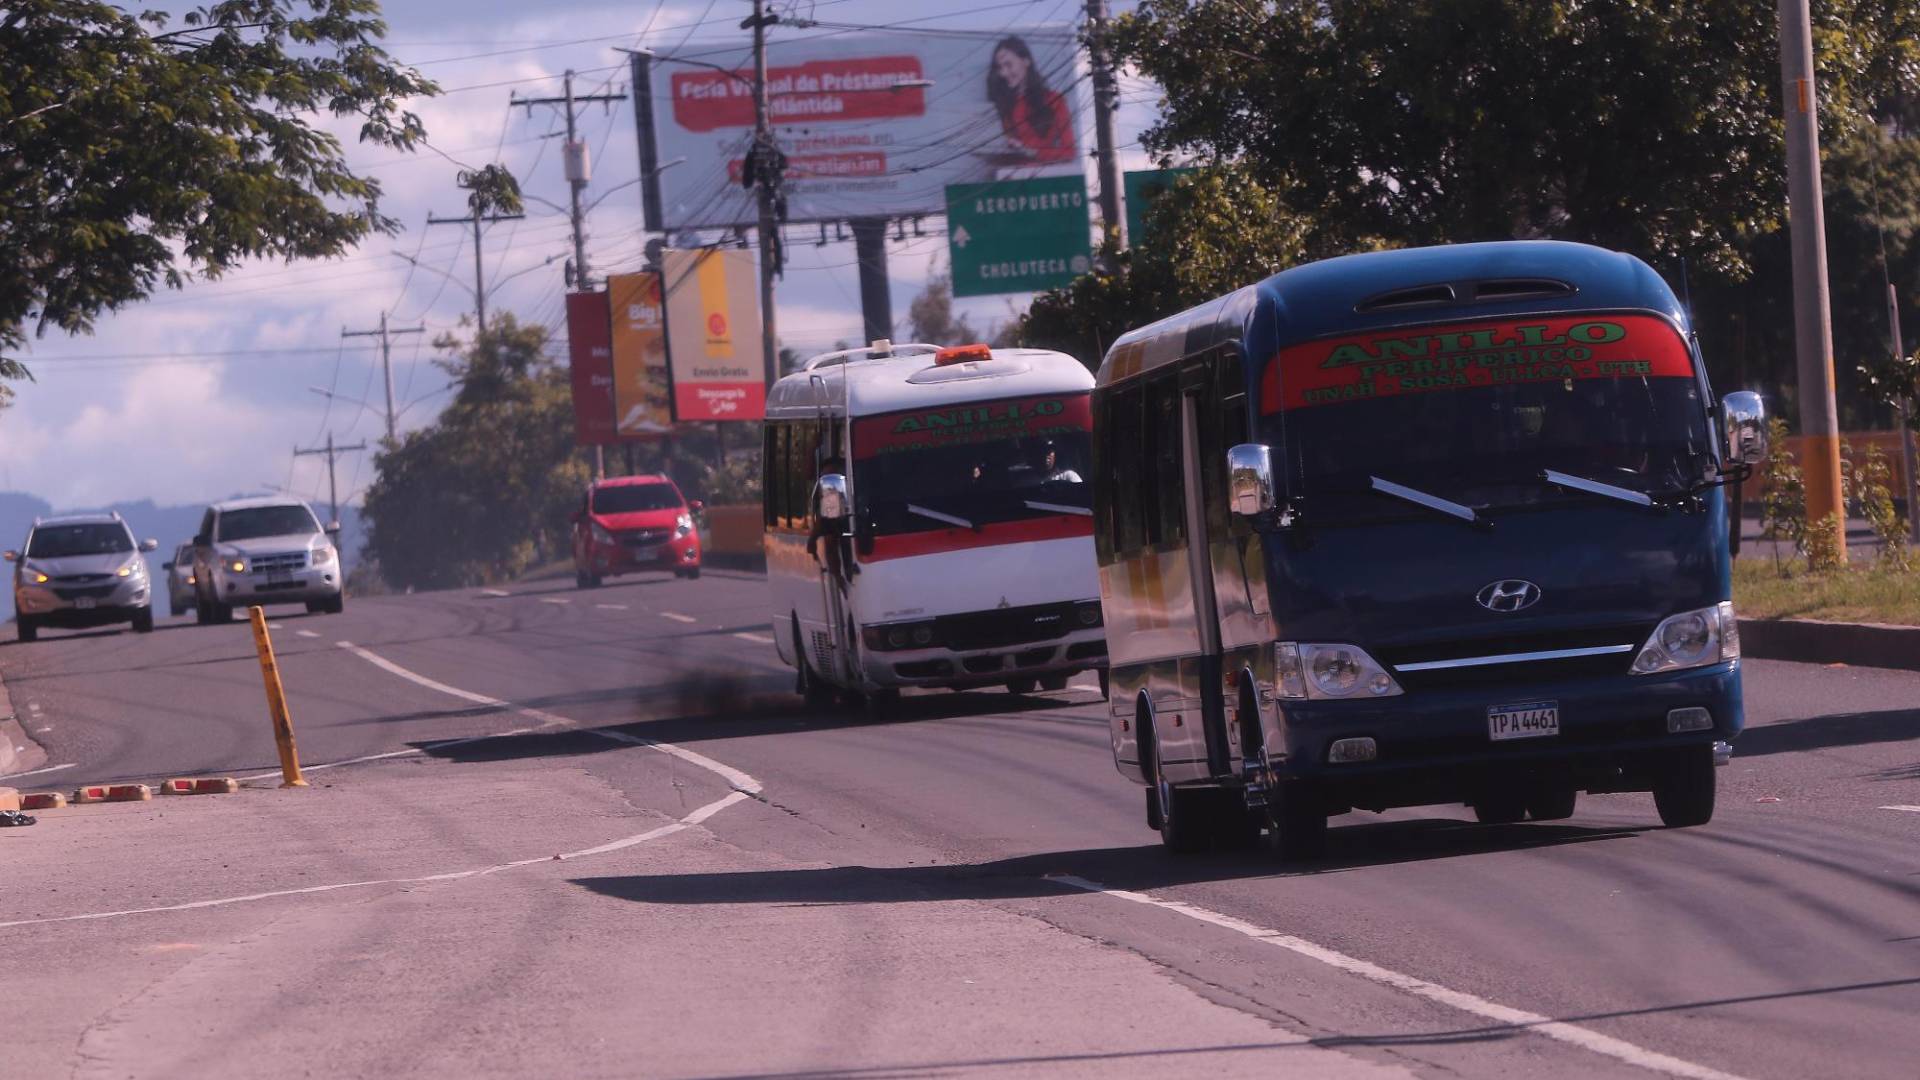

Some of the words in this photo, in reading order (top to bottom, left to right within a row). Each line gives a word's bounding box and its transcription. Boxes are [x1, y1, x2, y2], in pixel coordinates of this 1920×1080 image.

[681, 80, 728, 98] Feria
[795, 74, 818, 92] de
[767, 95, 843, 115] tlántida
[976, 192, 1082, 213] AEROPUERTO
[981, 259, 1066, 278] CHOLUTECA
[628, 303, 656, 324] Big
[1320, 321, 1626, 369] ANILLO
[1360, 347, 1592, 378] PERIFERICO
[1304, 383, 1376, 402] UNAH
[1401, 372, 1469, 389] SOSA
[1491, 364, 1576, 382] ULLOA
[1599, 361, 1651, 375] UTH
[894, 401, 1064, 433] ANILLO
[1491, 710, 1557, 733] TPA4461
